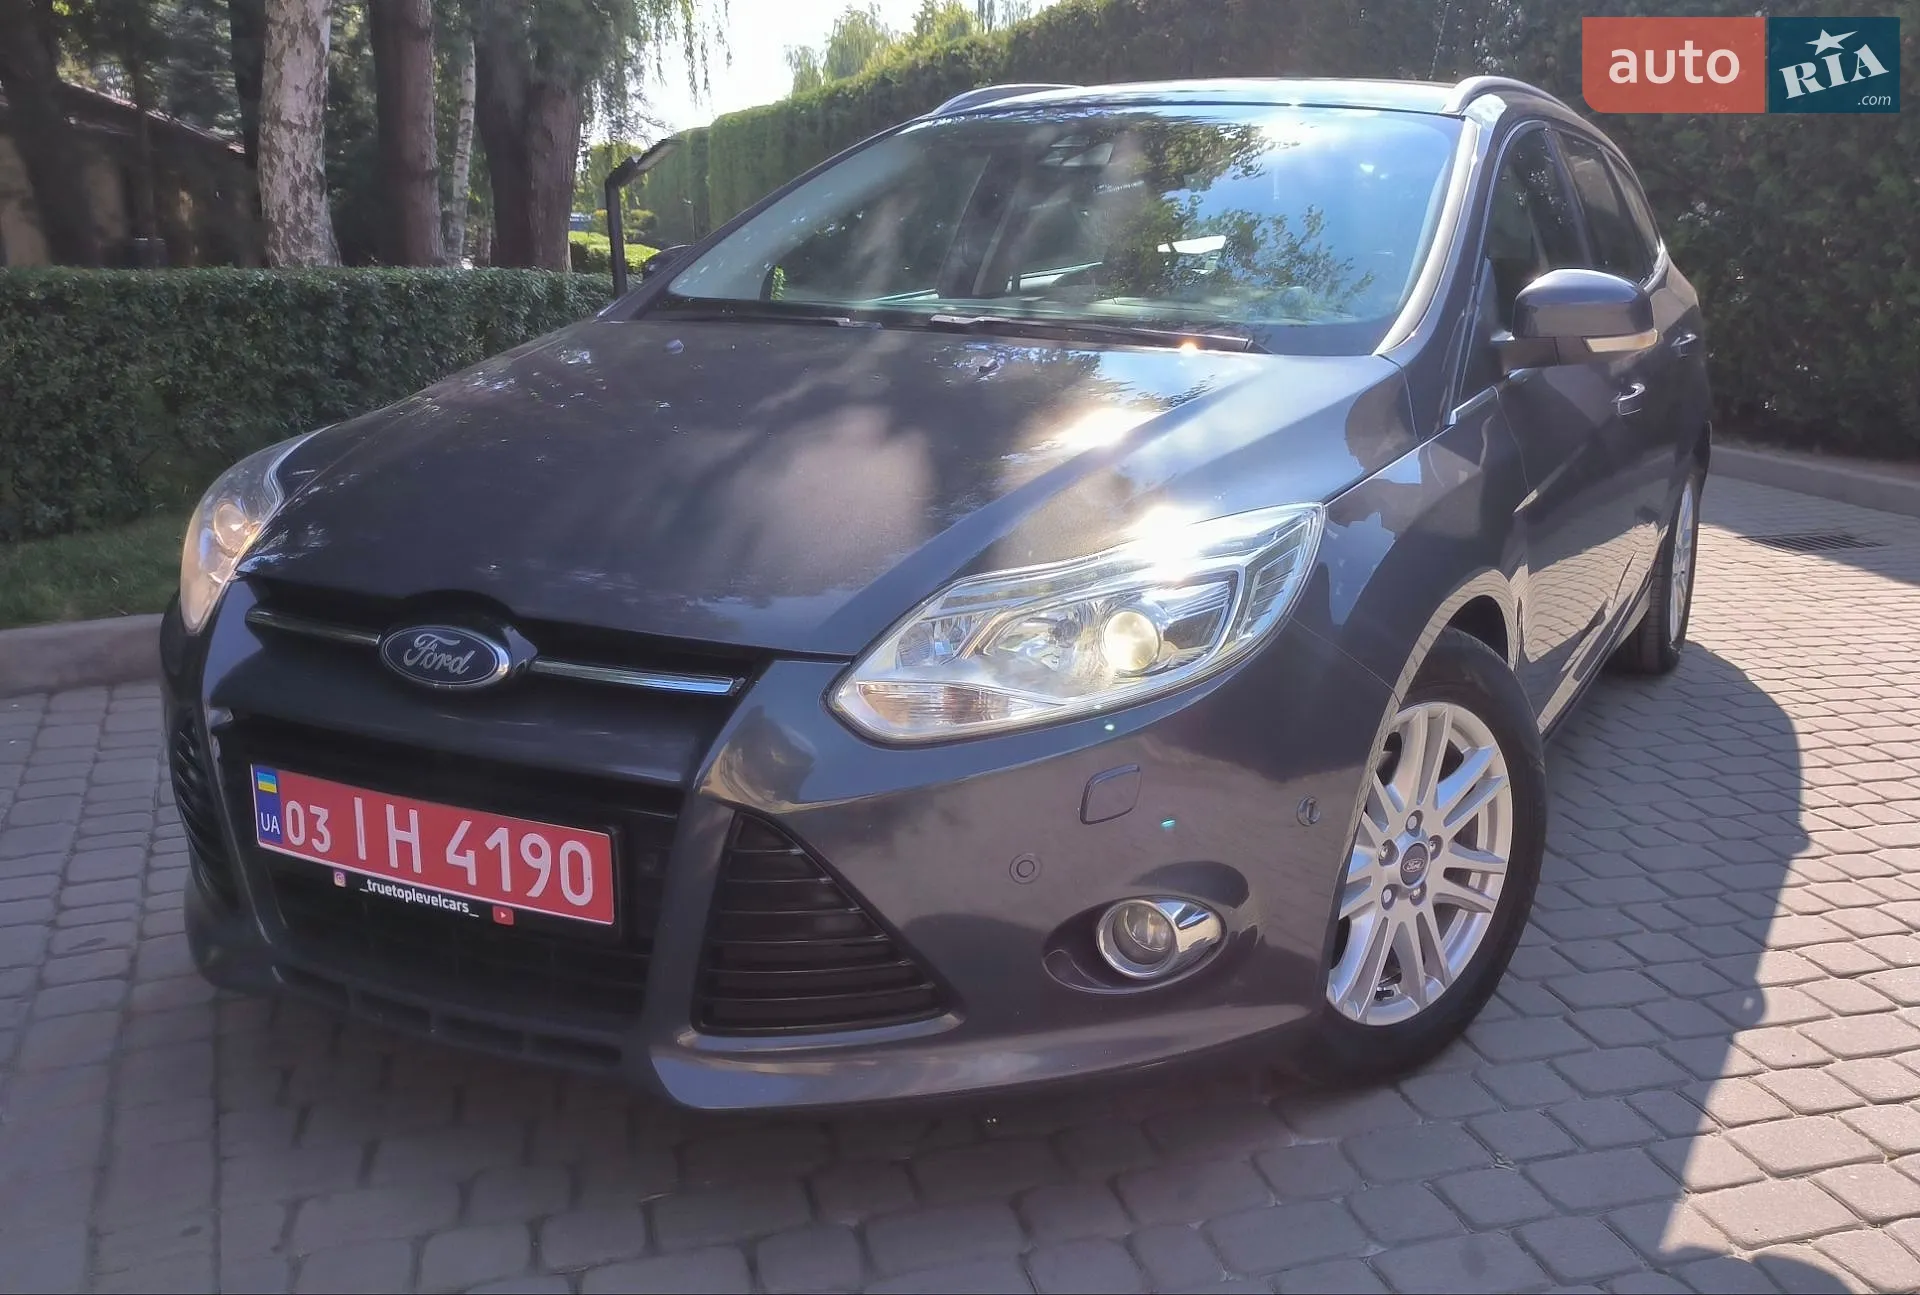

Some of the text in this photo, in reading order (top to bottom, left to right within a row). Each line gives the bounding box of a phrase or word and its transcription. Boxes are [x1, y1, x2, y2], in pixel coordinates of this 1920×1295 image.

[403, 633, 476, 675] Ford
[260, 812, 281, 835] UA
[285, 797, 593, 906] 03 IH 4190
[360, 879, 479, 918] _truetoplevelcars_
